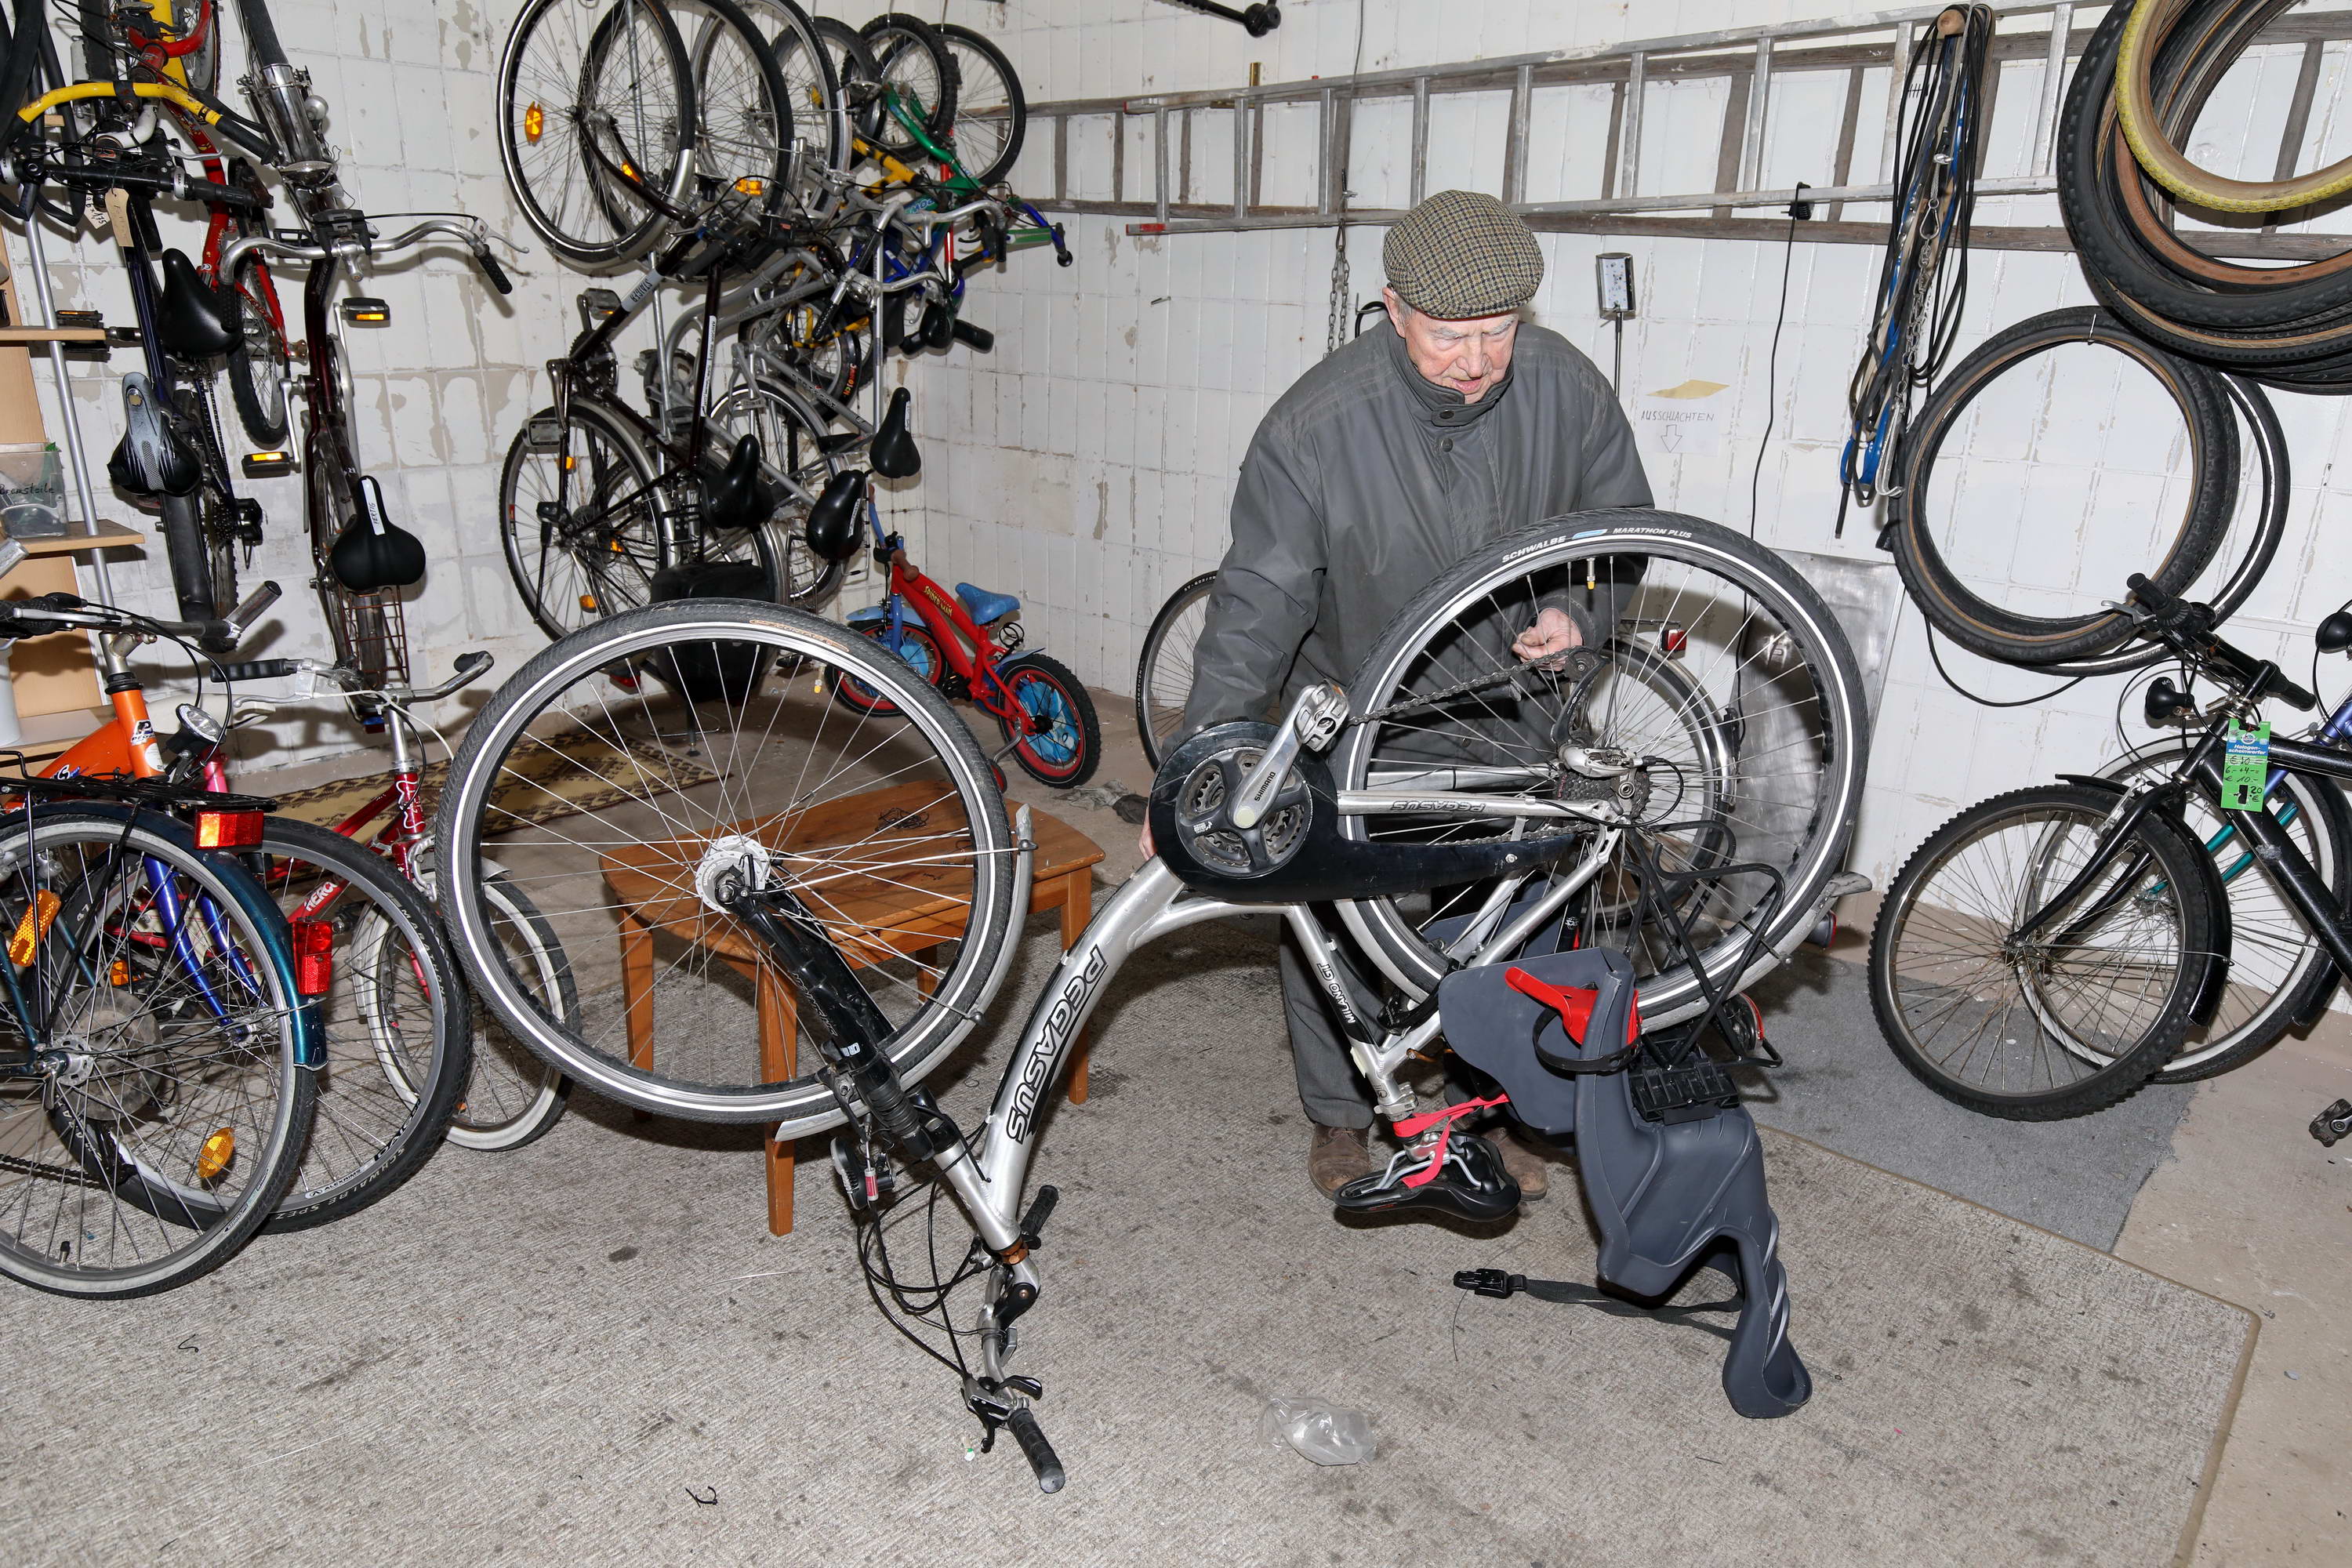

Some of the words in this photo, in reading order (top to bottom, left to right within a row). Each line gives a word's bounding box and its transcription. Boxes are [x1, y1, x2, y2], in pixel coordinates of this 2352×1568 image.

[1640, 409, 1715, 423] AUSSCHLACHTEN
[1613, 527, 1667, 535] MARATHON
[1668, 529, 1693, 539] PLUS
[1501, 535, 1566, 564] SCHWALBE
[2234, 743, 2261, 752] Halogen-
[1254, 771, 1276, 803] SHIMANO
[2250, 786, 2263, 794] 20
[1389, 800, 1486, 813] PEGASUS
[401, 908, 446, 994] MARATHON
[1316, 963, 1335, 982] GT
[1328, 982, 1356, 1025] MILANO
[1006, 944, 1109, 1145] PEGASUS
[327, 1147, 405, 1206] SCHWALBE
